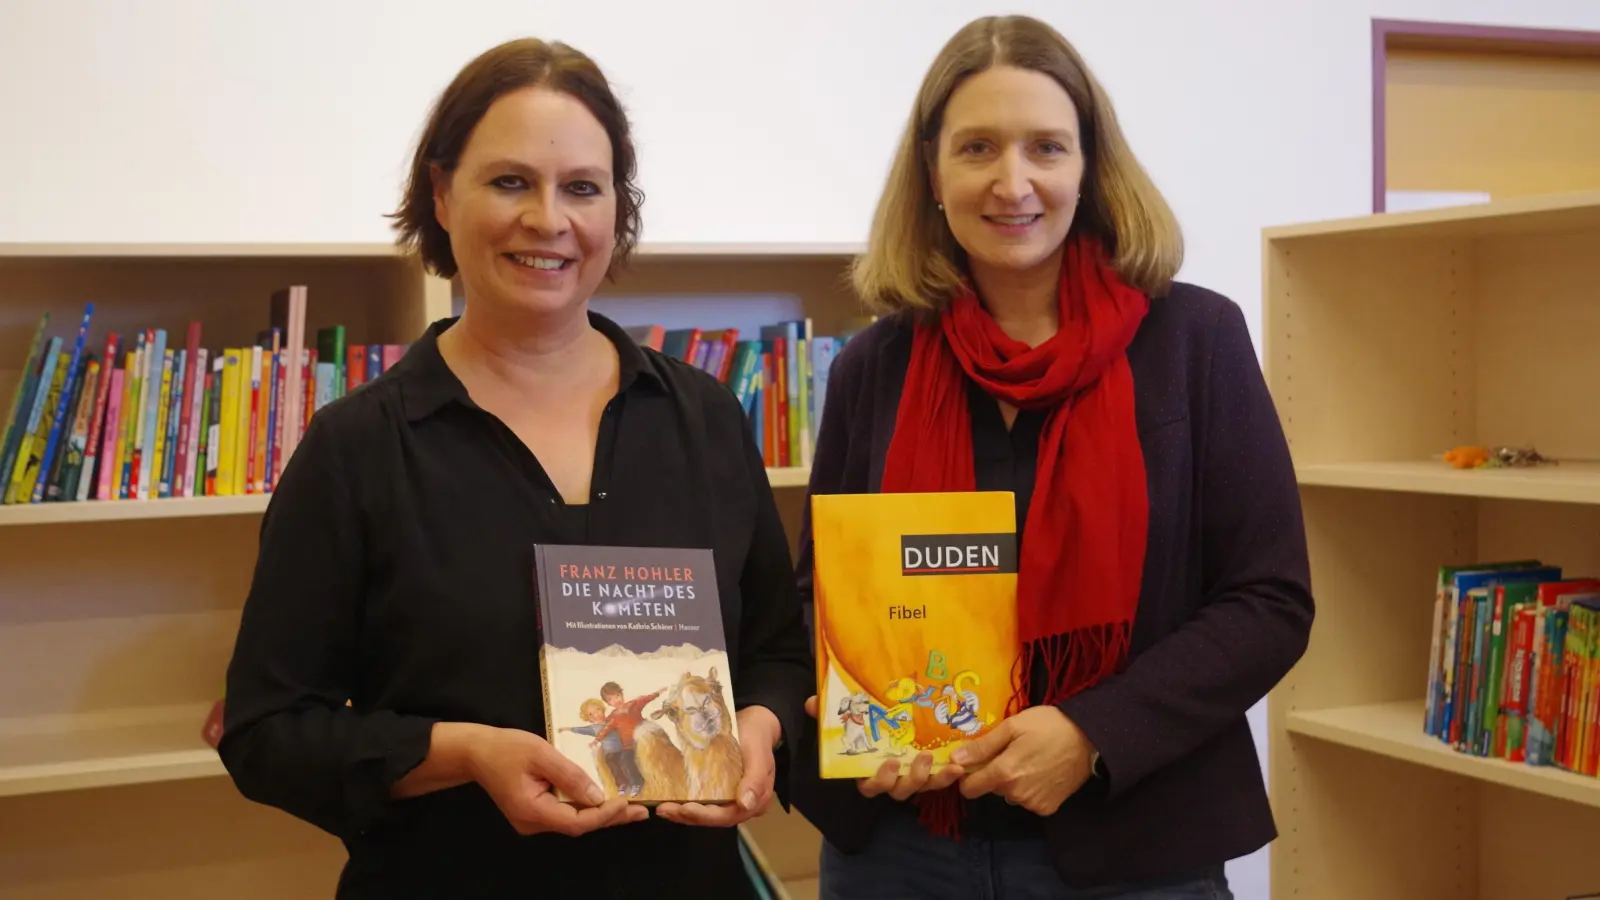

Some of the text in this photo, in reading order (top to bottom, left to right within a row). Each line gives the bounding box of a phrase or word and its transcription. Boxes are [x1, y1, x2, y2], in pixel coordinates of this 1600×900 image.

[904, 545, 999, 568] DUDEN
[560, 564, 694, 581] FRANZ HOHLER
[562, 582, 696, 600] DIE NACHT DES
[889, 605, 927, 621] Fibel
[565, 621, 577, 629] Mit
[926, 650, 949, 680] B
